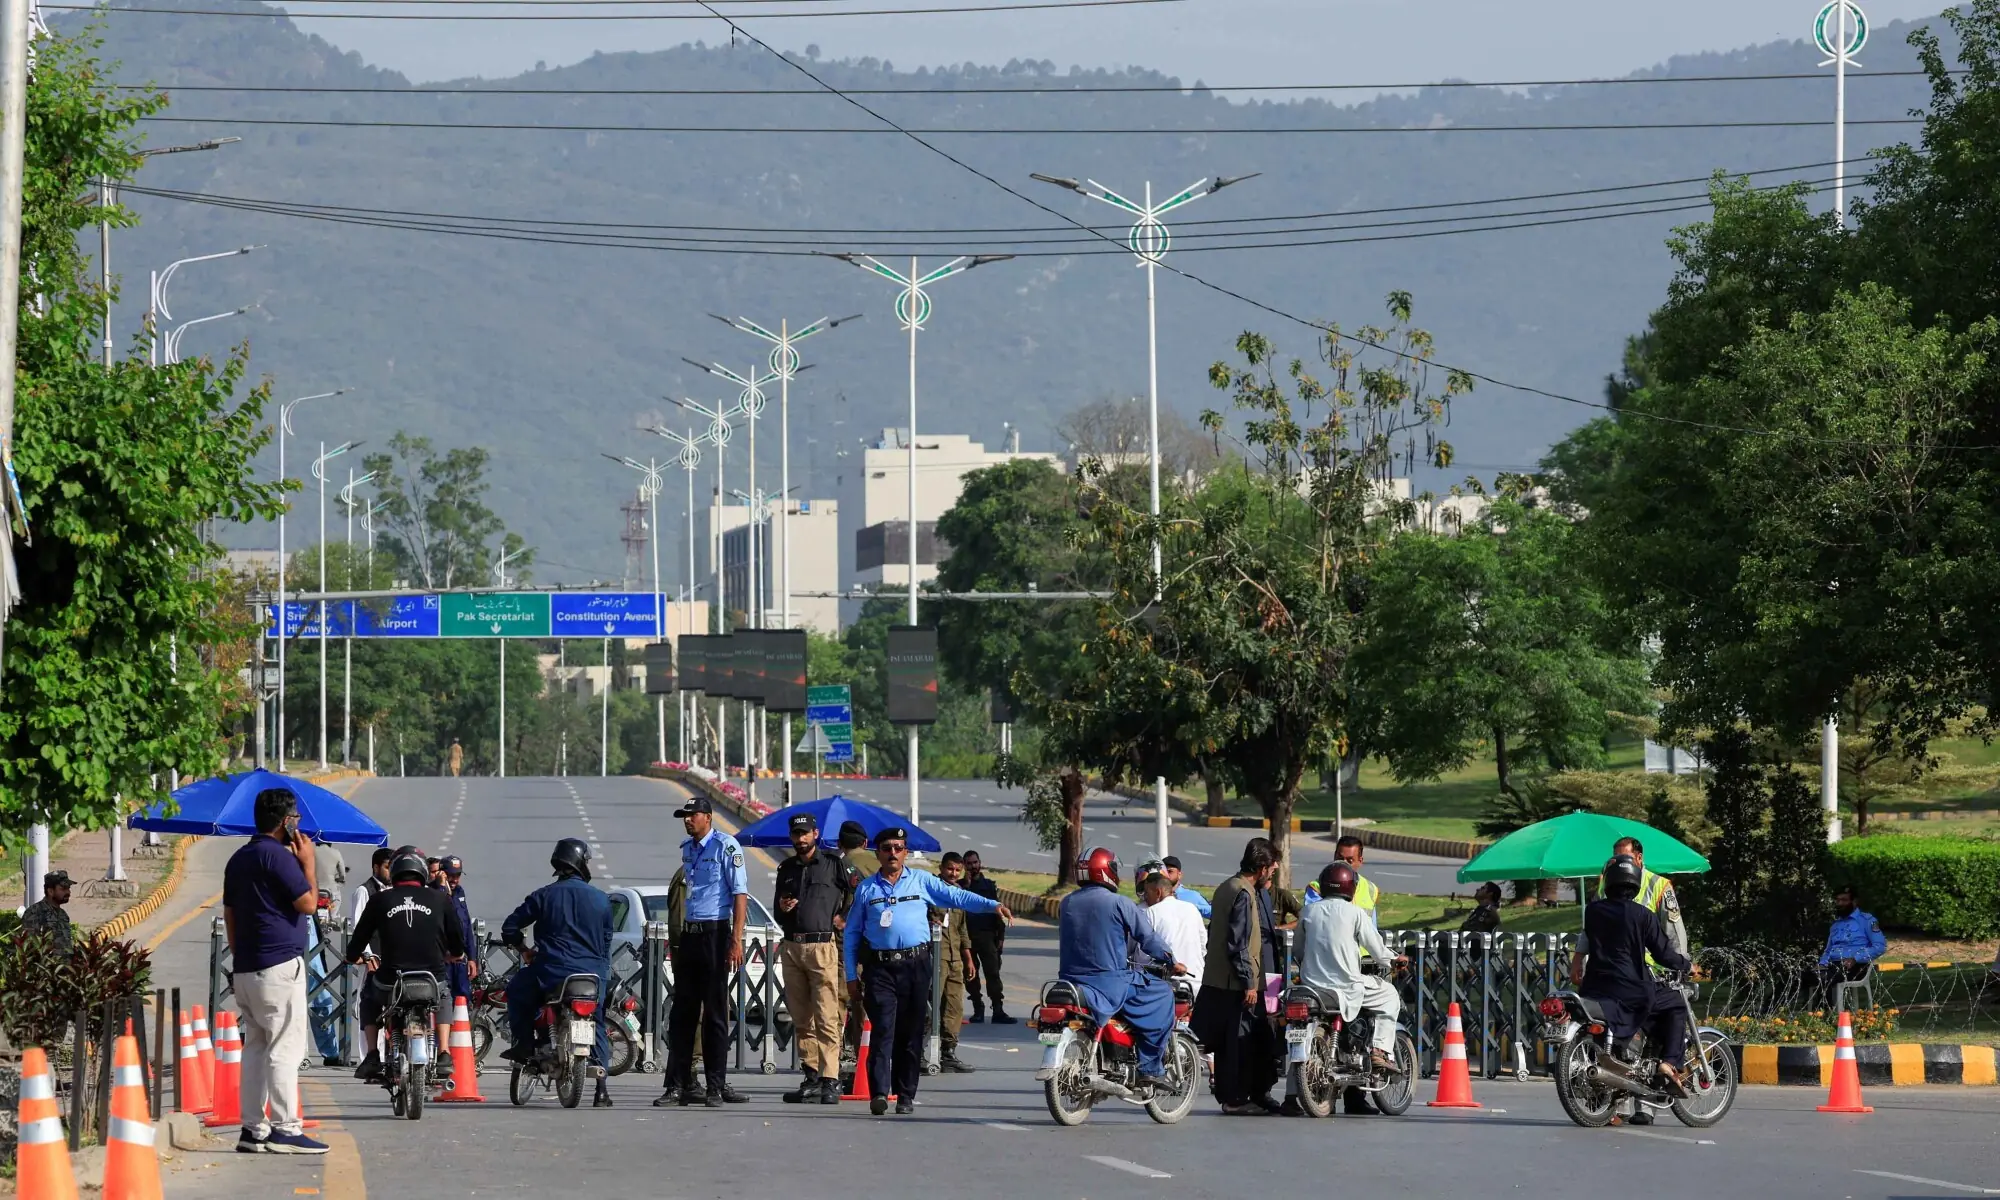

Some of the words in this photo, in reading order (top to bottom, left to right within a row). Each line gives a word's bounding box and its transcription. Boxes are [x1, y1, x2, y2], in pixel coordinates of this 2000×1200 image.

[457, 612, 475, 621] Pak
[478, 612, 535, 621] Secretariat
[556, 611, 620, 621] Constitution
[623, 611, 656, 621] Avenu
[387, 904, 432, 918] COMMANDO
